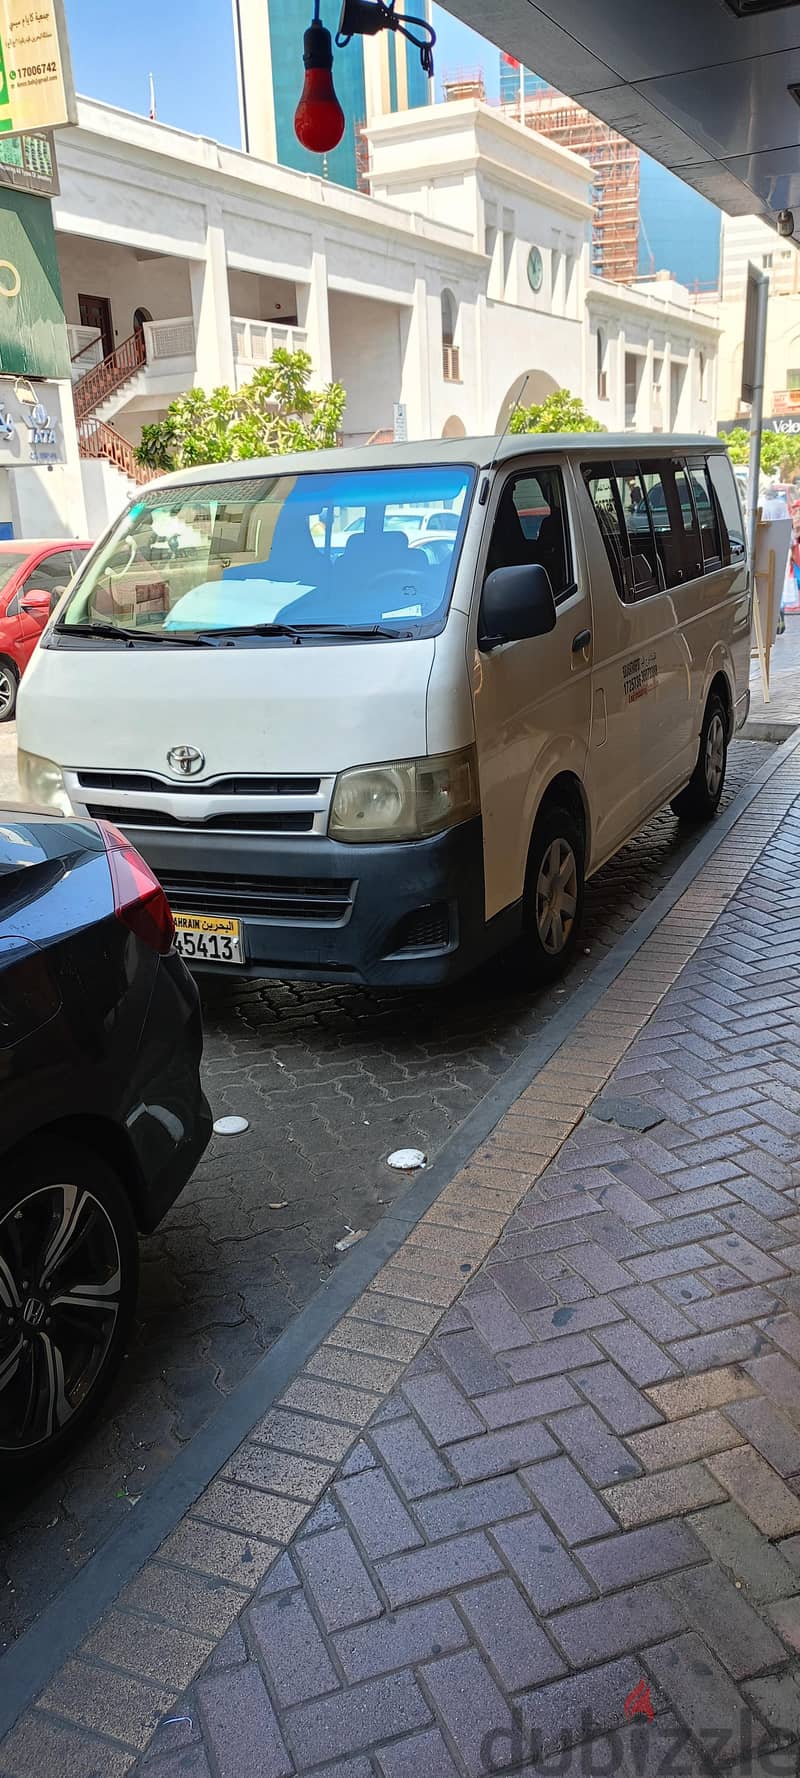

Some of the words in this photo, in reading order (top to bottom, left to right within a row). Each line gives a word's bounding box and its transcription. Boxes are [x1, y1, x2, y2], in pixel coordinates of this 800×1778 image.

[17, 62, 57, 79] 17006742
[174, 917, 200, 929] AHRAIN
[201, 920, 234, 933] البحرين
